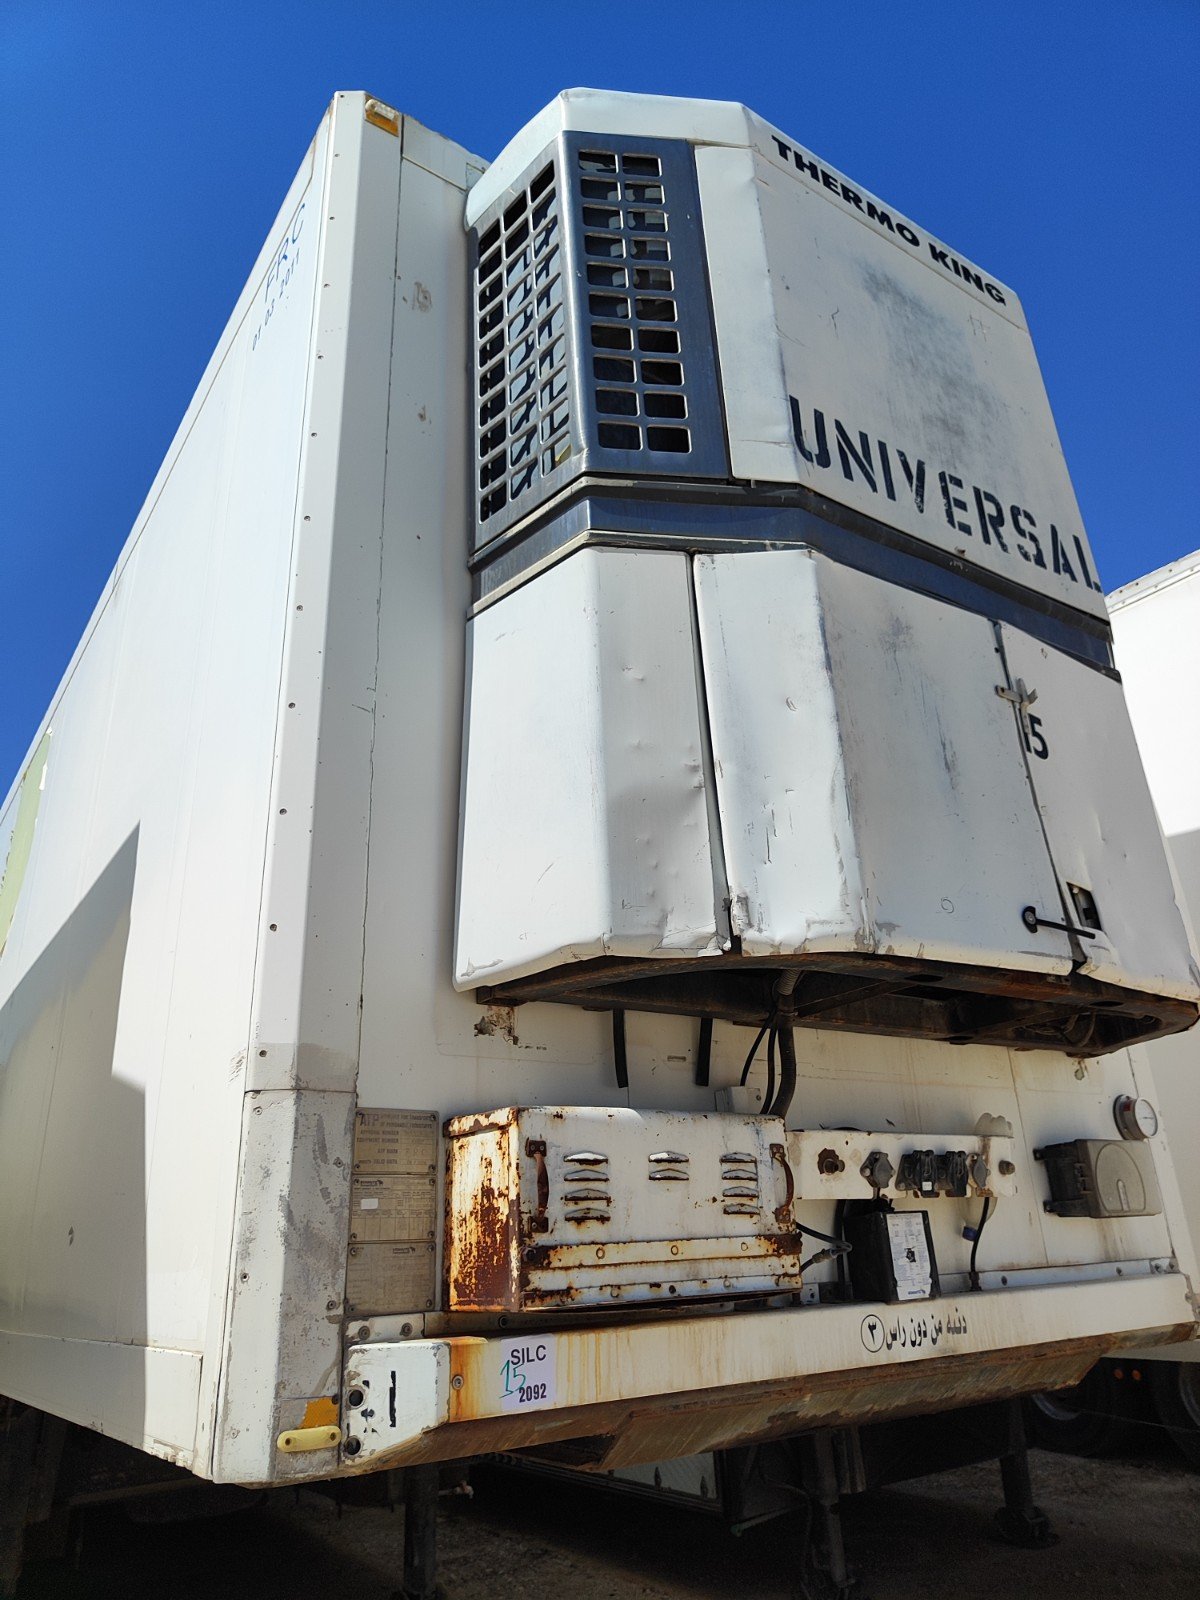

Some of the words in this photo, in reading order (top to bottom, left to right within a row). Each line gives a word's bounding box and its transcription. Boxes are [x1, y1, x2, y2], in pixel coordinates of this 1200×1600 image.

[771, 134, 920, 247] THERMO
[928, 242, 1006, 306] KING
[265, 203, 305, 303] FRC
[789, 394, 1103, 593] UNIVERSAL
[910, 1317, 927, 1348] دون
[930, 1314, 943, 1345] من
[510, 1344, 547, 1365] SILC
[518, 1382, 547, 1404] 2092
